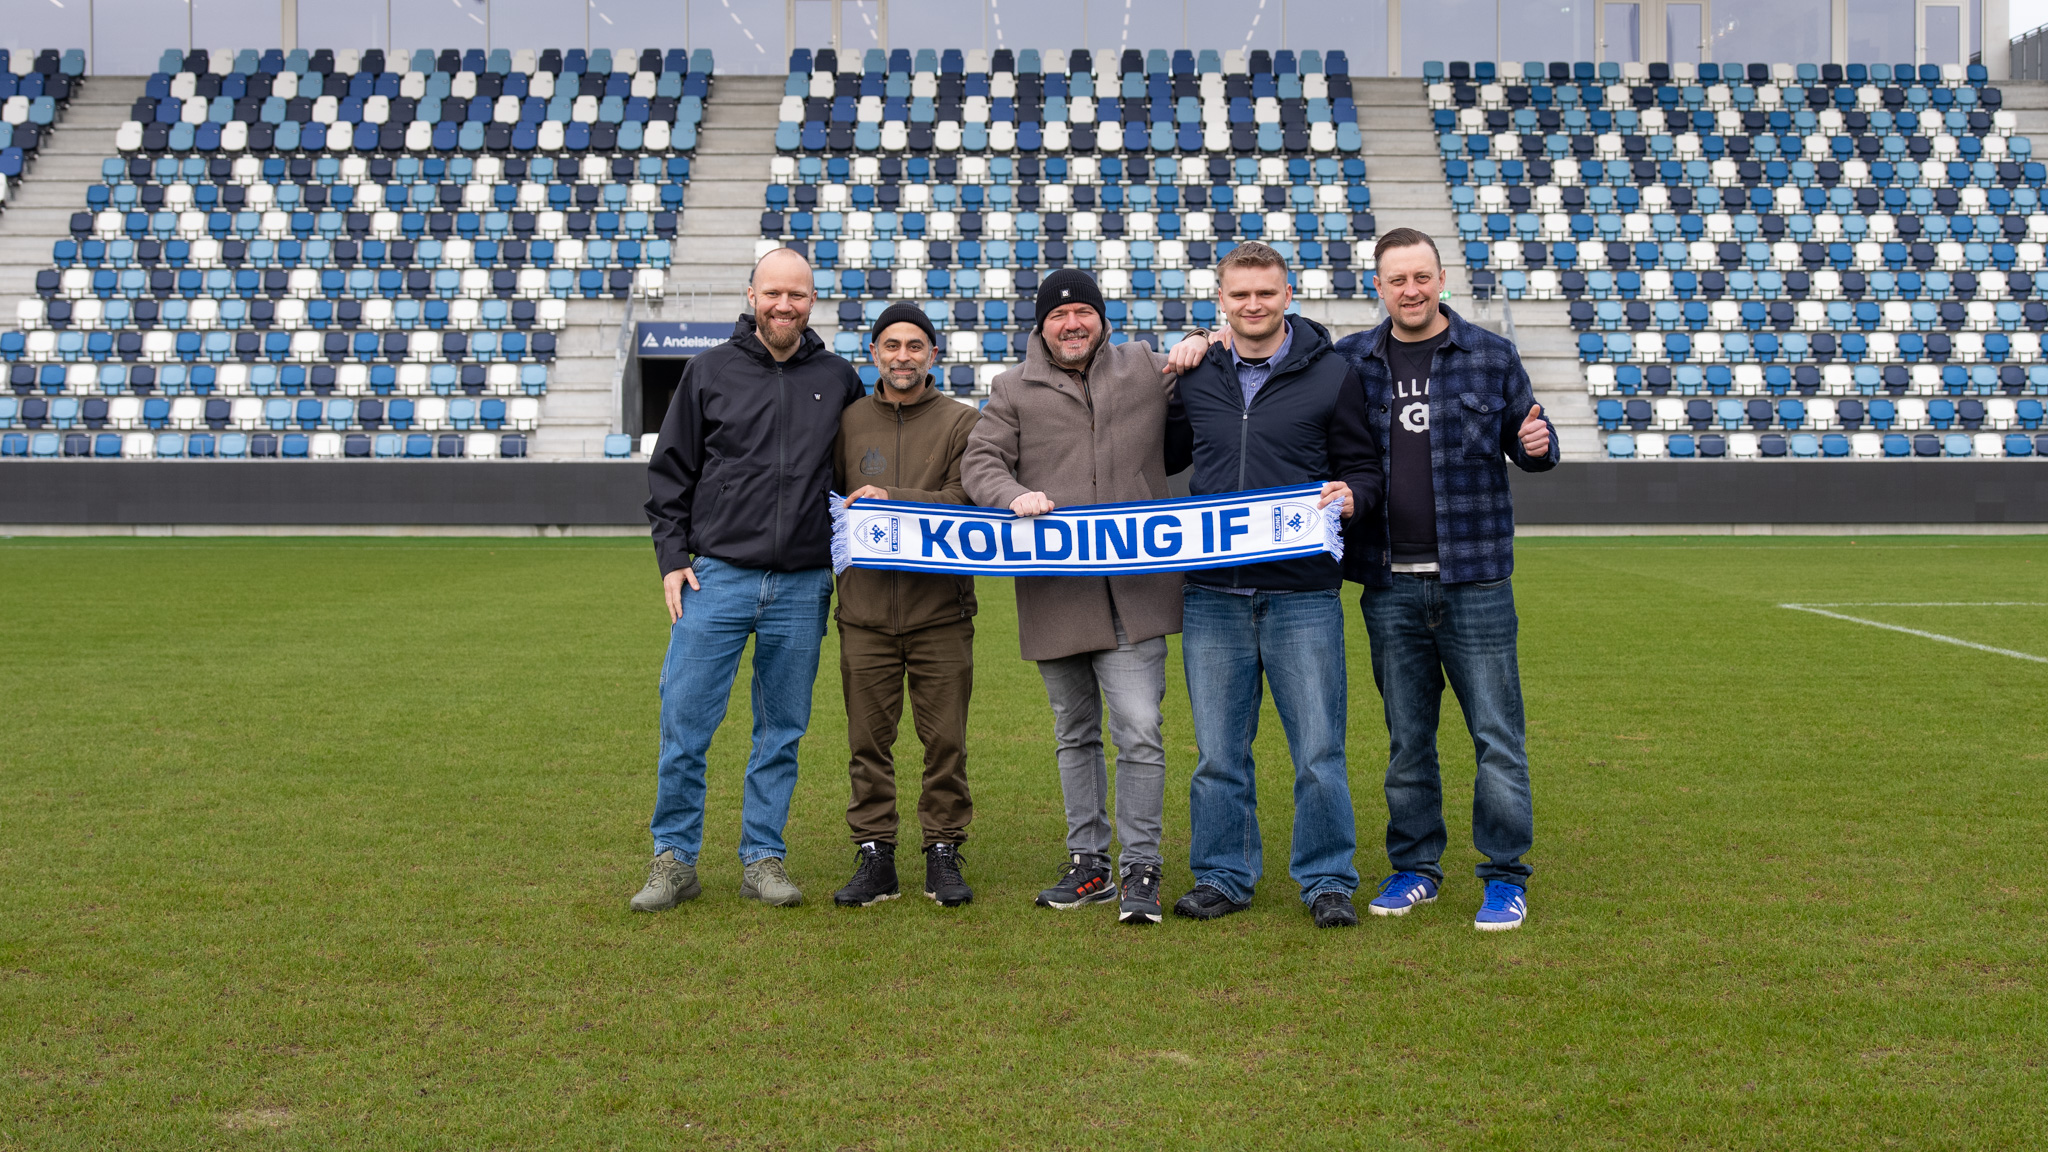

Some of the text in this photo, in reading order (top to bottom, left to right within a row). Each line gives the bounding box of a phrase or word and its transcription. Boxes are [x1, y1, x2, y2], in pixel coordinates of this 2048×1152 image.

[662, 336, 731, 348] Andelskas
[919, 507, 1250, 561] KOLDING IF
